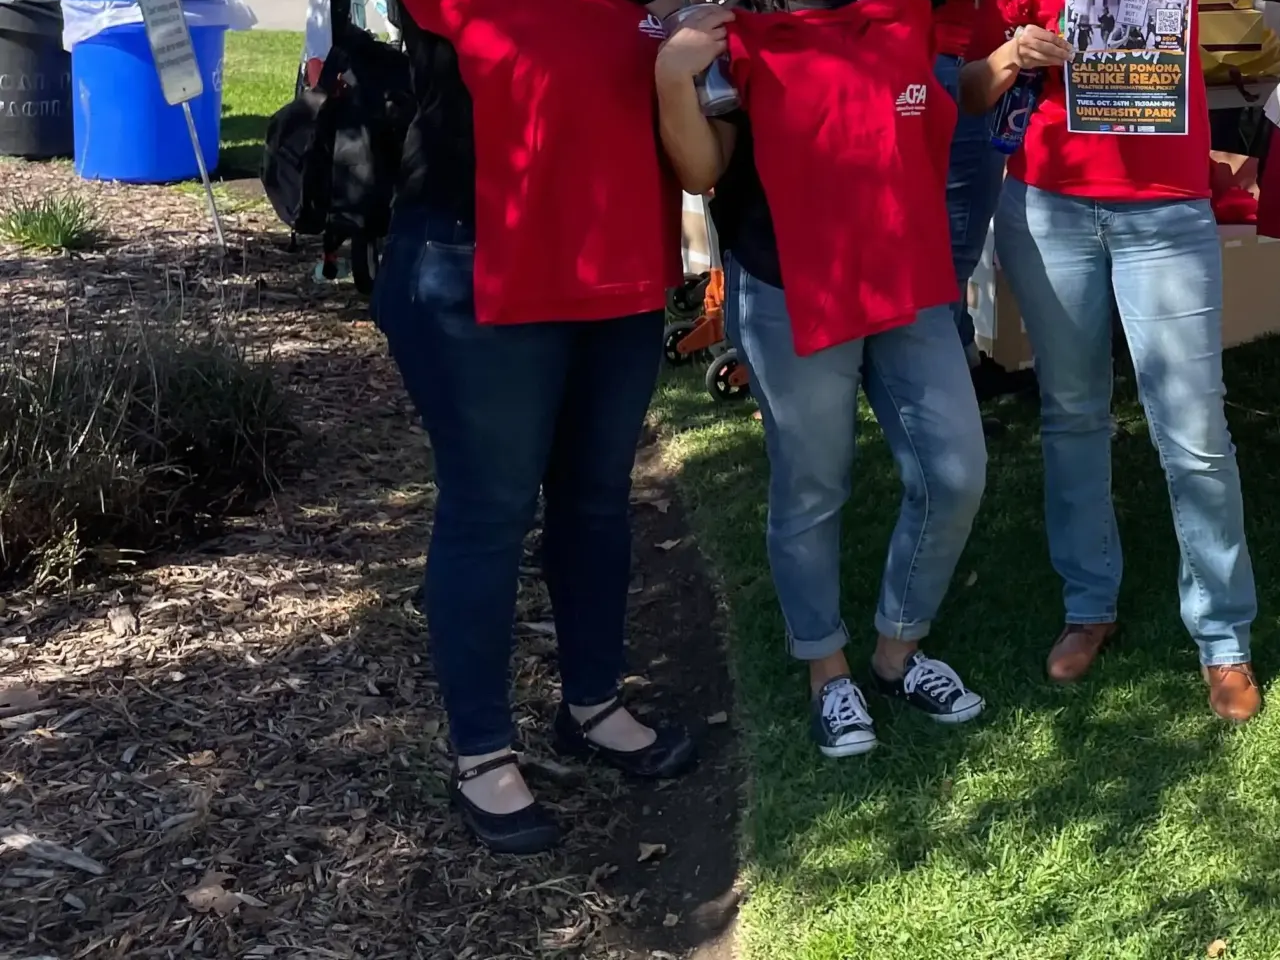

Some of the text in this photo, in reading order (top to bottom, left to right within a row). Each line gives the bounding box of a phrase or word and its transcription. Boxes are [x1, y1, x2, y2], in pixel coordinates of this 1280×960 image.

[1072, 64, 1181, 73] CAL POLY POMONA
[1072, 72, 1182, 84] STRIKE READY
[906, 84, 926, 104] CFA
[1076, 107, 1176, 117] UNIVERSITY PARK
